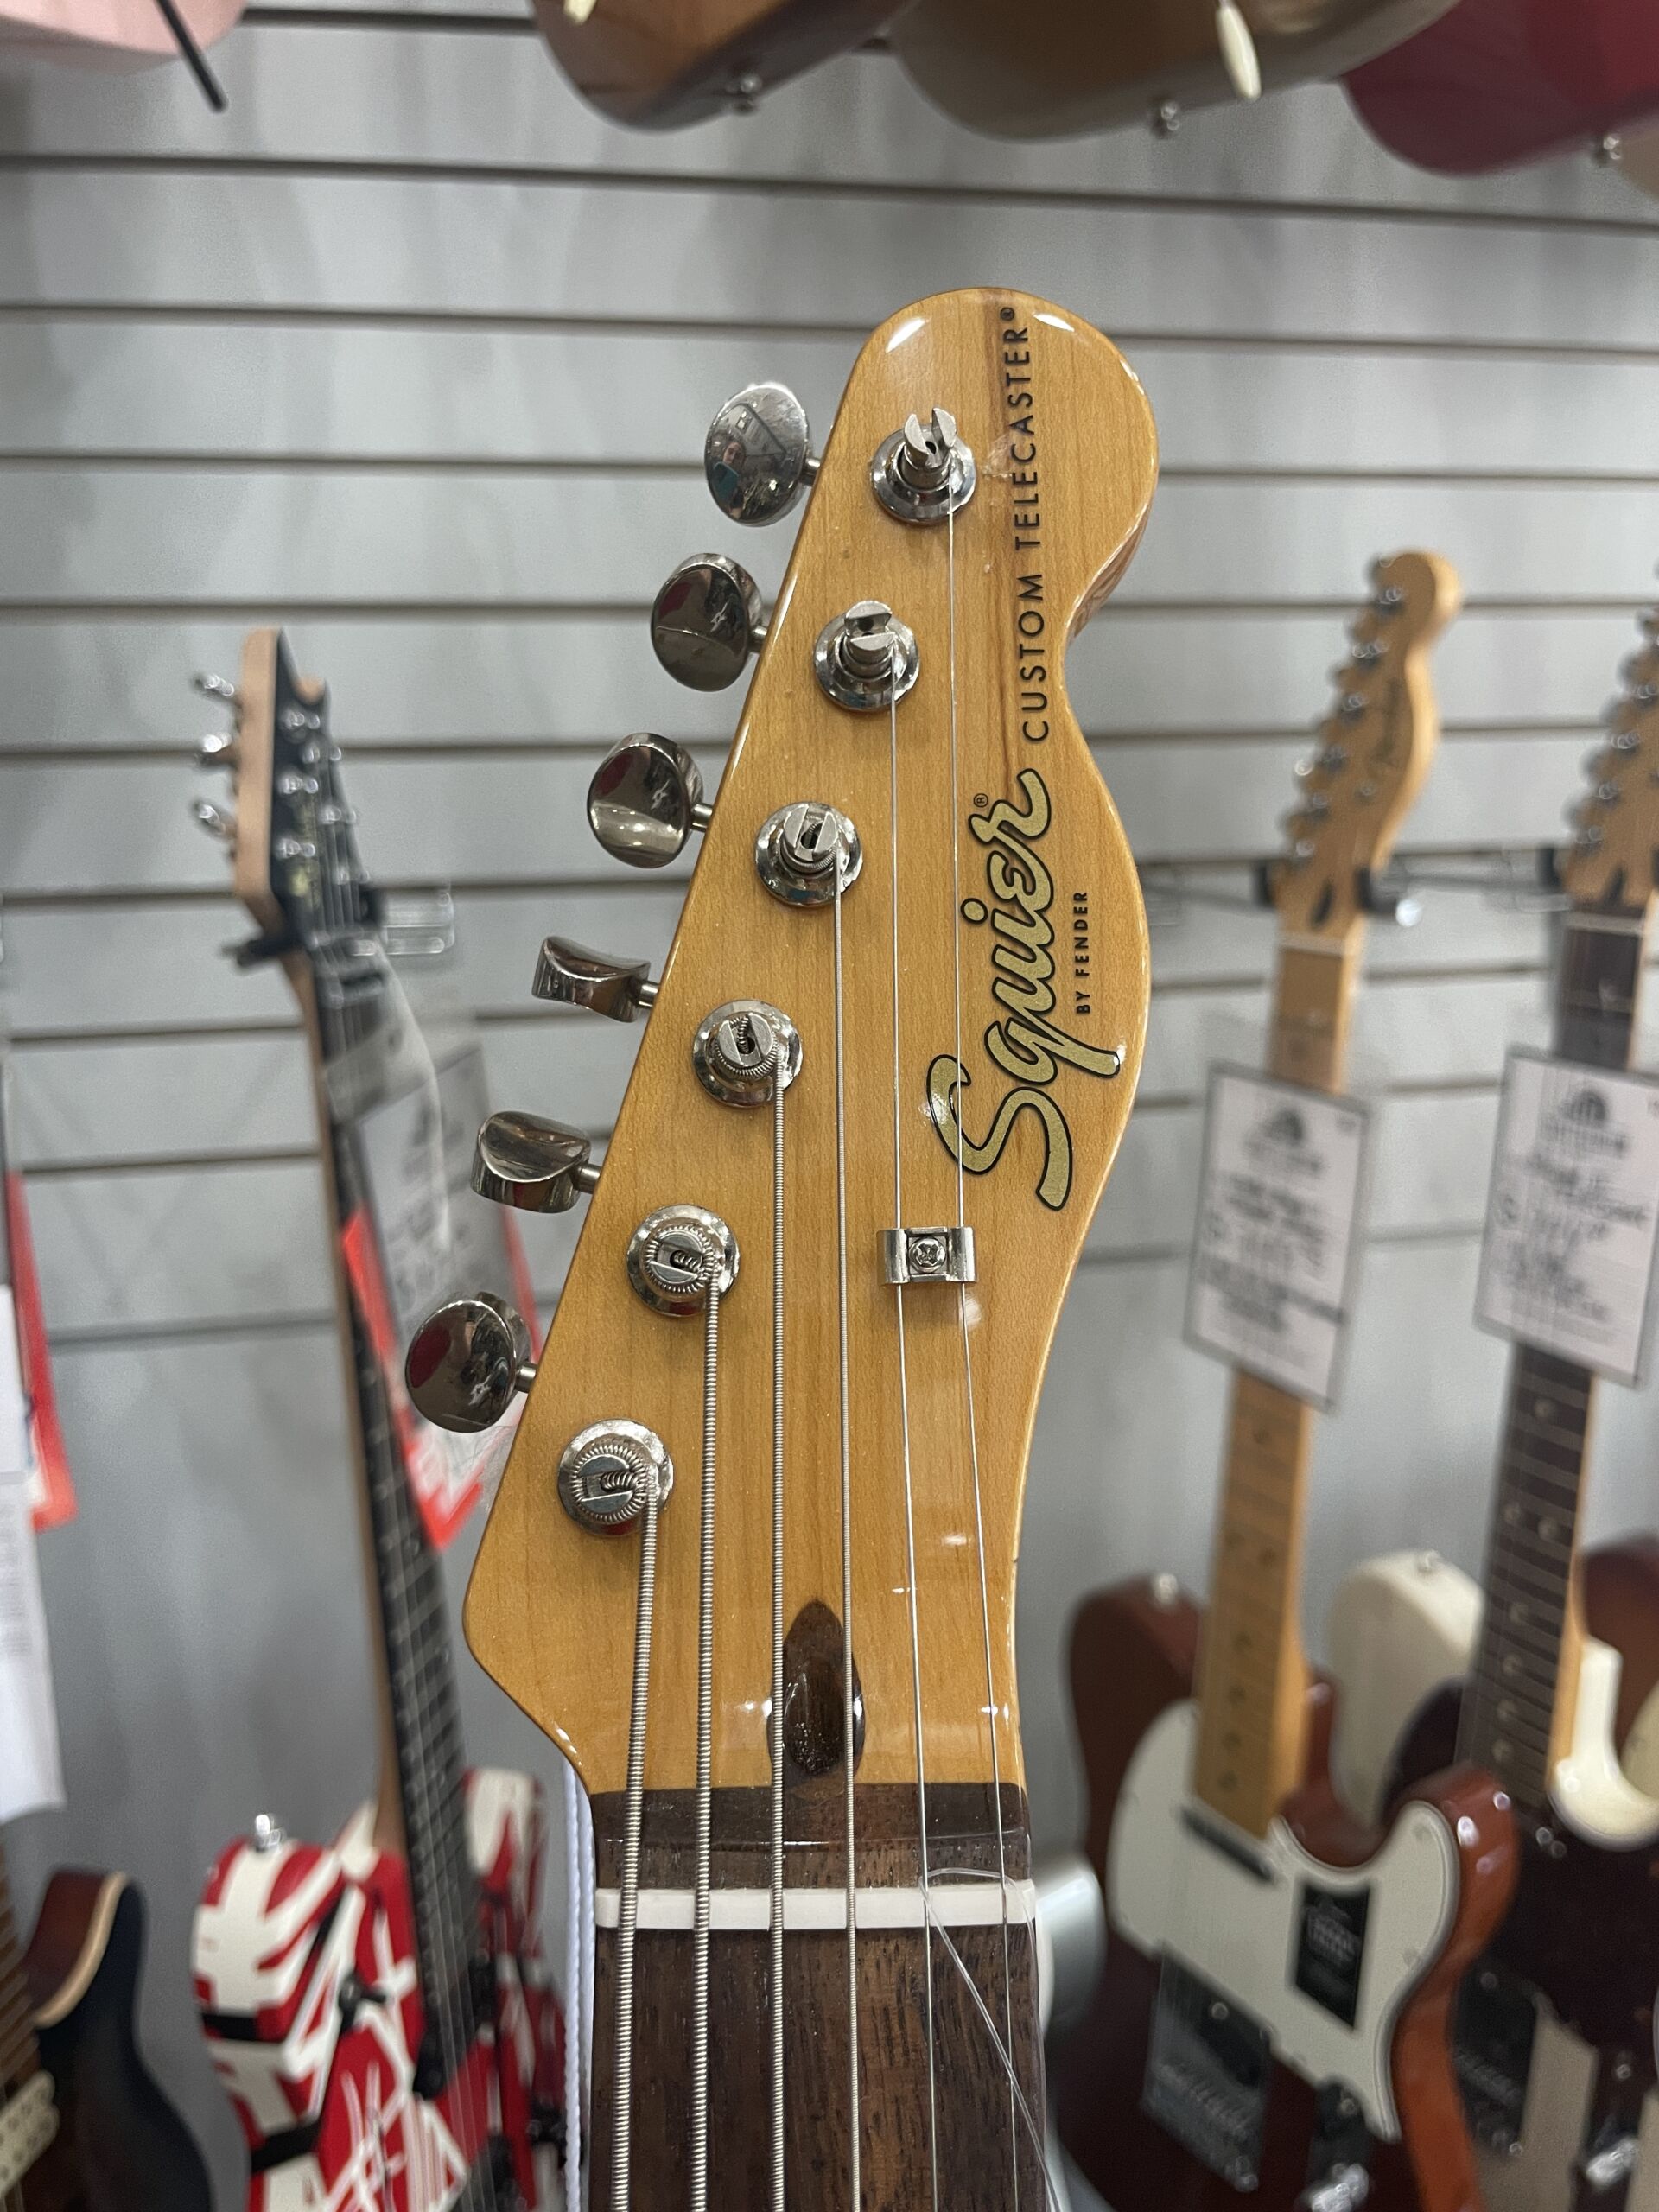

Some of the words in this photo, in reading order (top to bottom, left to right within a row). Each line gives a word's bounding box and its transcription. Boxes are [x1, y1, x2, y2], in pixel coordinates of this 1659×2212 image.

[1017, 574, 1050, 743] CUSTOM
[1073, 891, 1090, 977] FENDER
[1075, 987, 1091, 1015] BY
